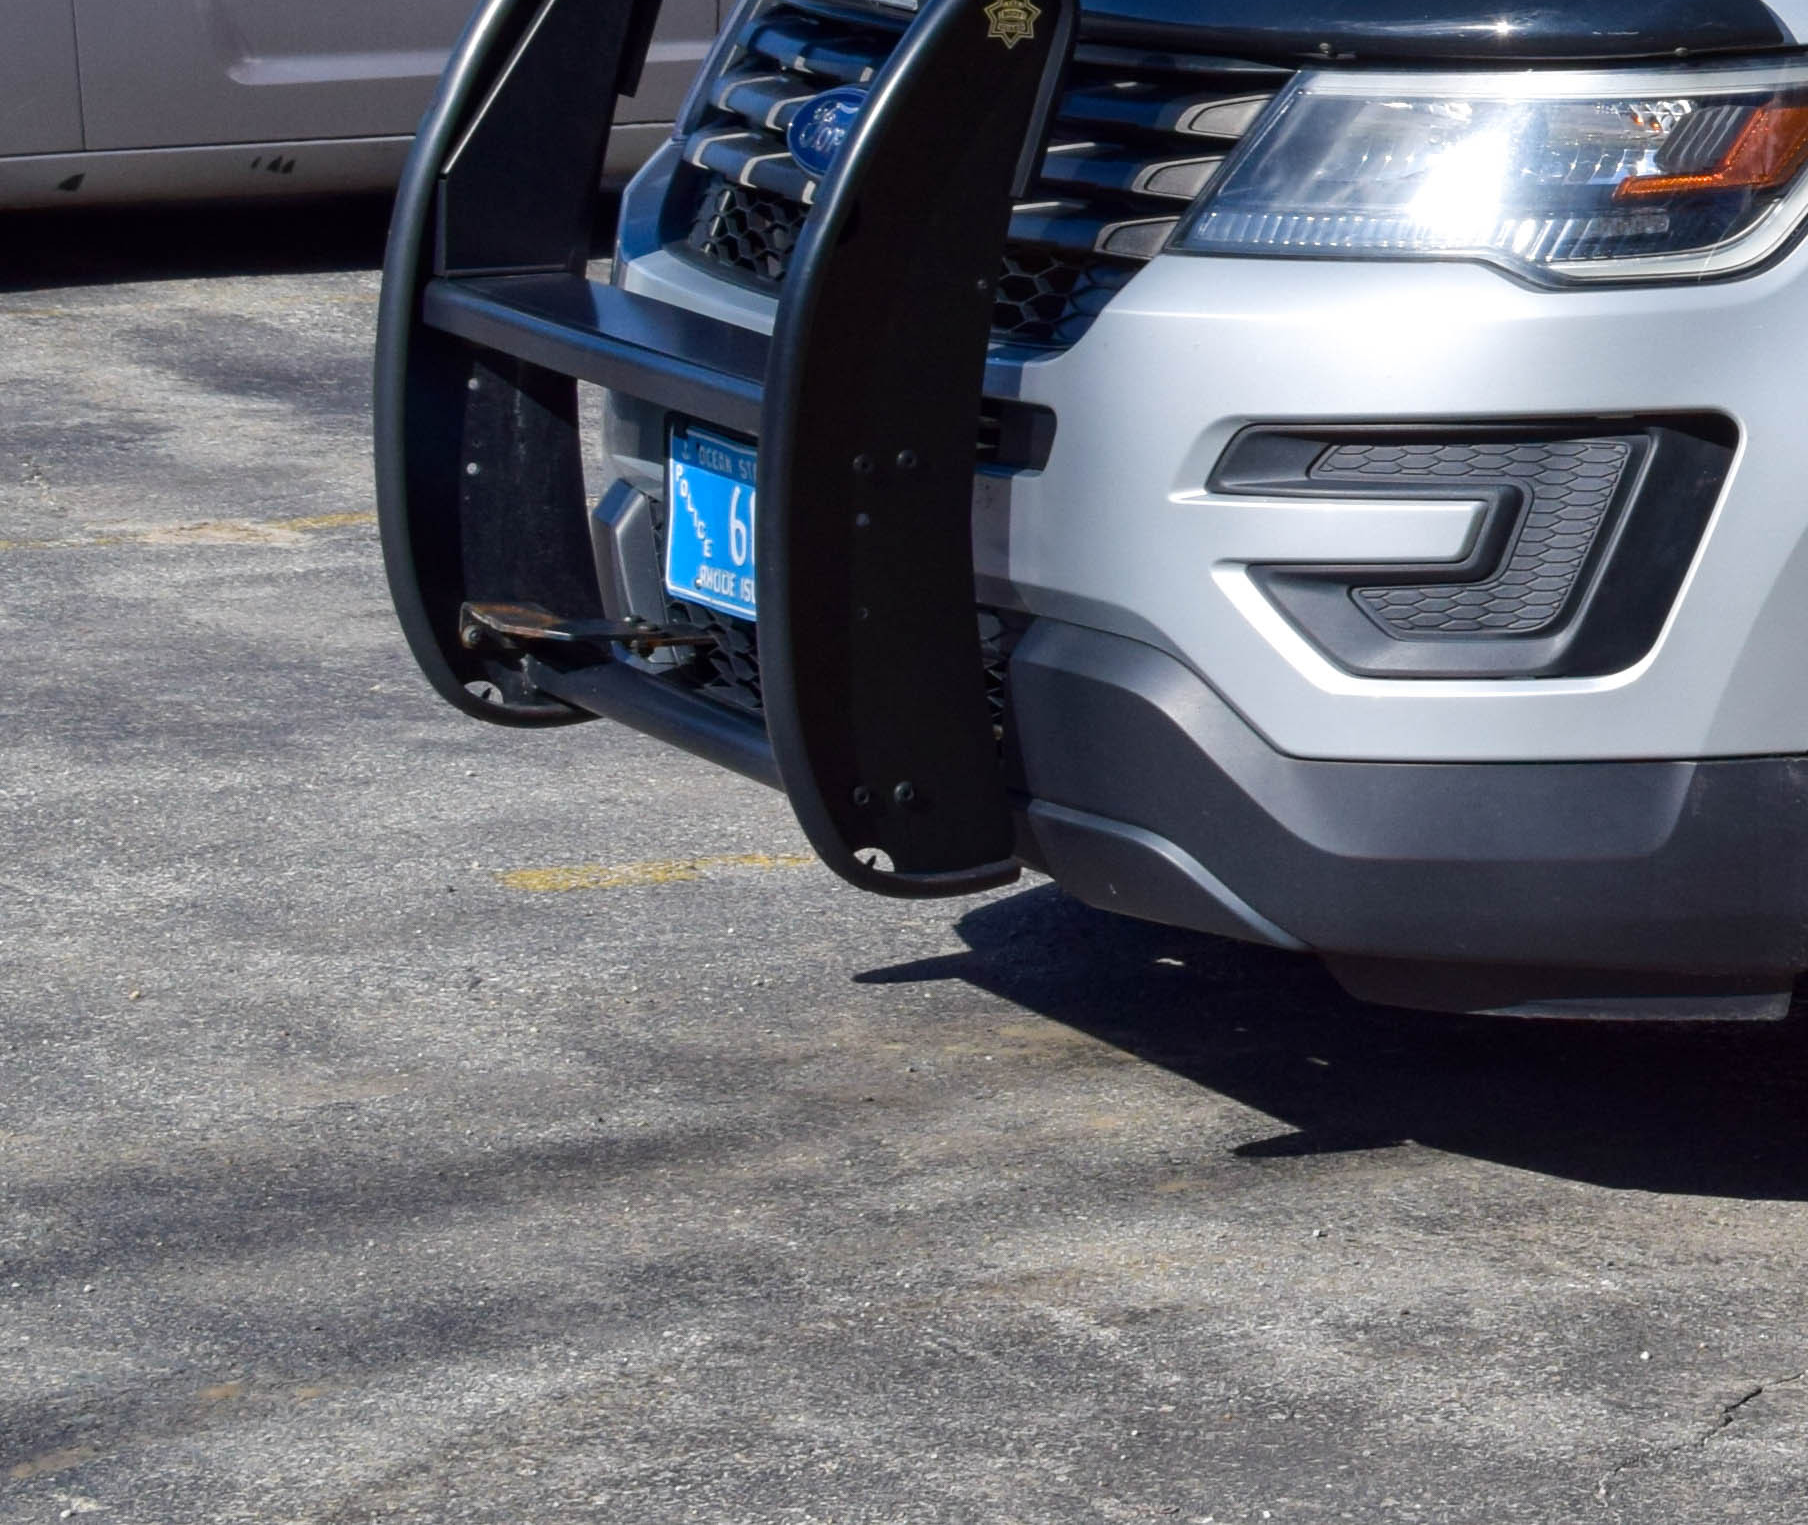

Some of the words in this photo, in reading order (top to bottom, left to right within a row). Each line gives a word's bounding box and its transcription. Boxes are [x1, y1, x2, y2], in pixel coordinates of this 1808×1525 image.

[698, 445, 733, 473] OCEAN
[675, 464, 713, 558] POLICE
[729, 485, 757, 567] 6
